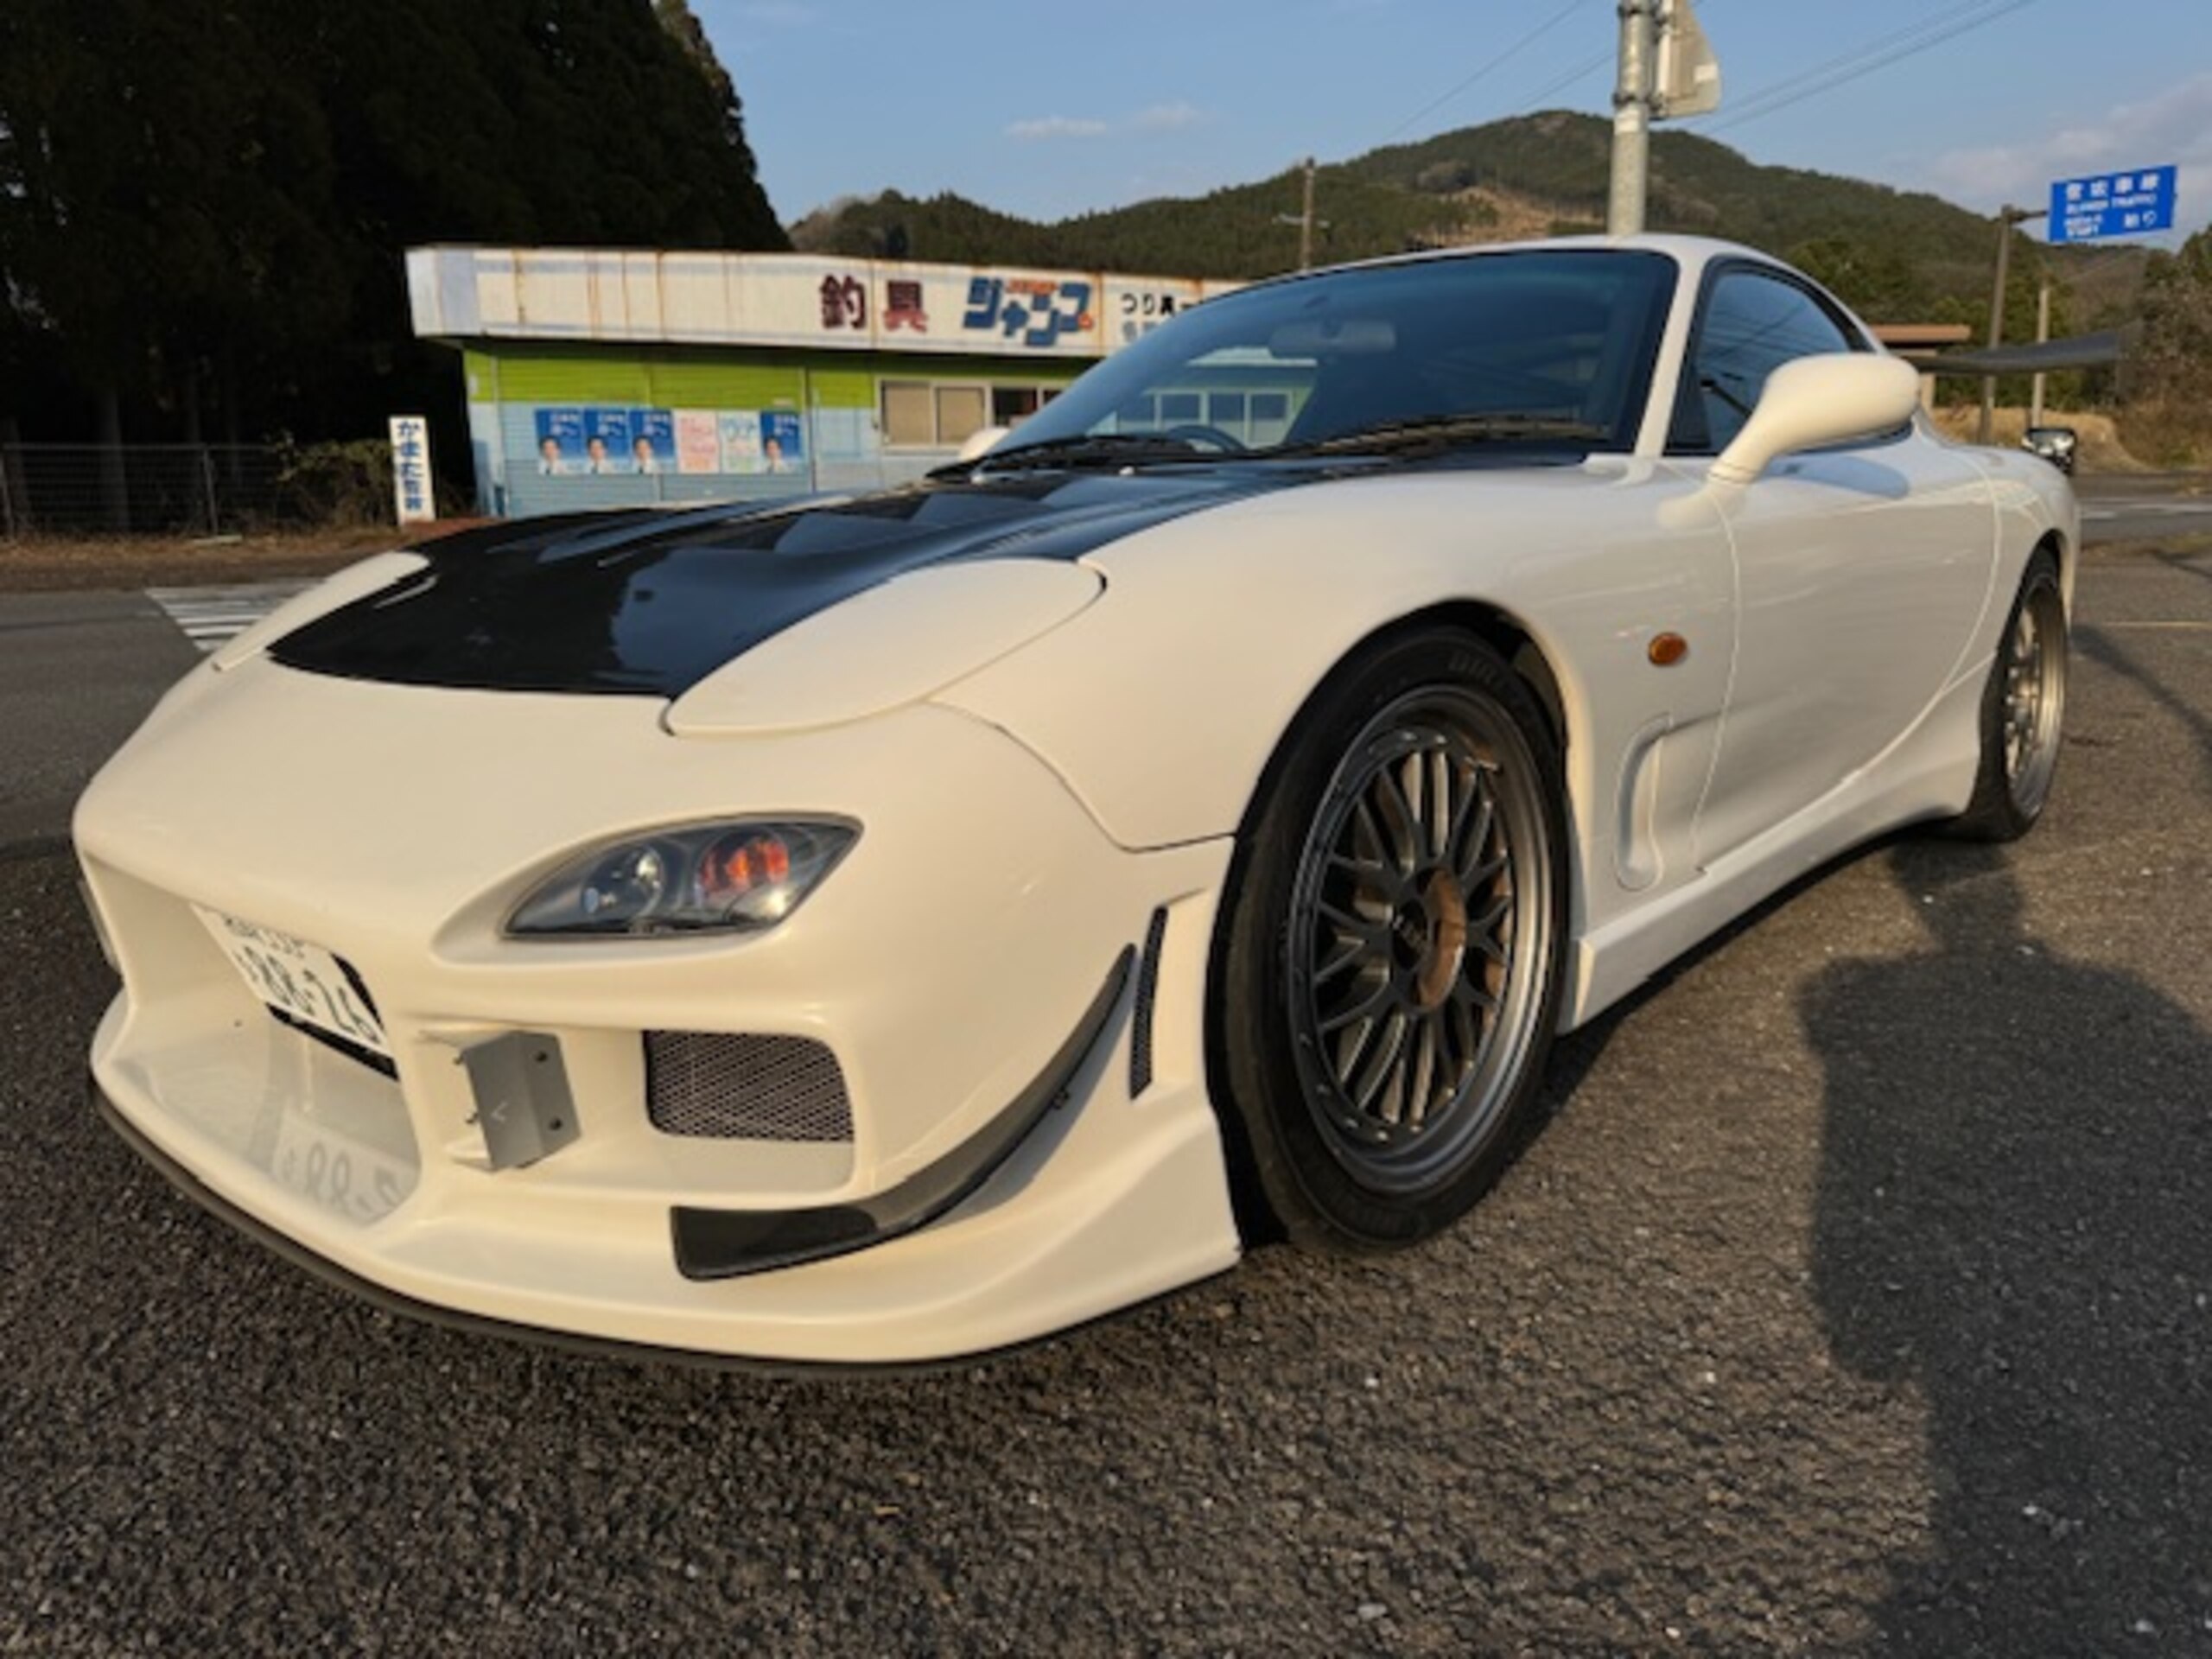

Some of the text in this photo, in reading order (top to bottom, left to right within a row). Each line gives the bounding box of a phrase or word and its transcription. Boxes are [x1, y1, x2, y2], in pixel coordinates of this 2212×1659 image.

[819, 274, 1094, 347] 釣具 ジャンプ
